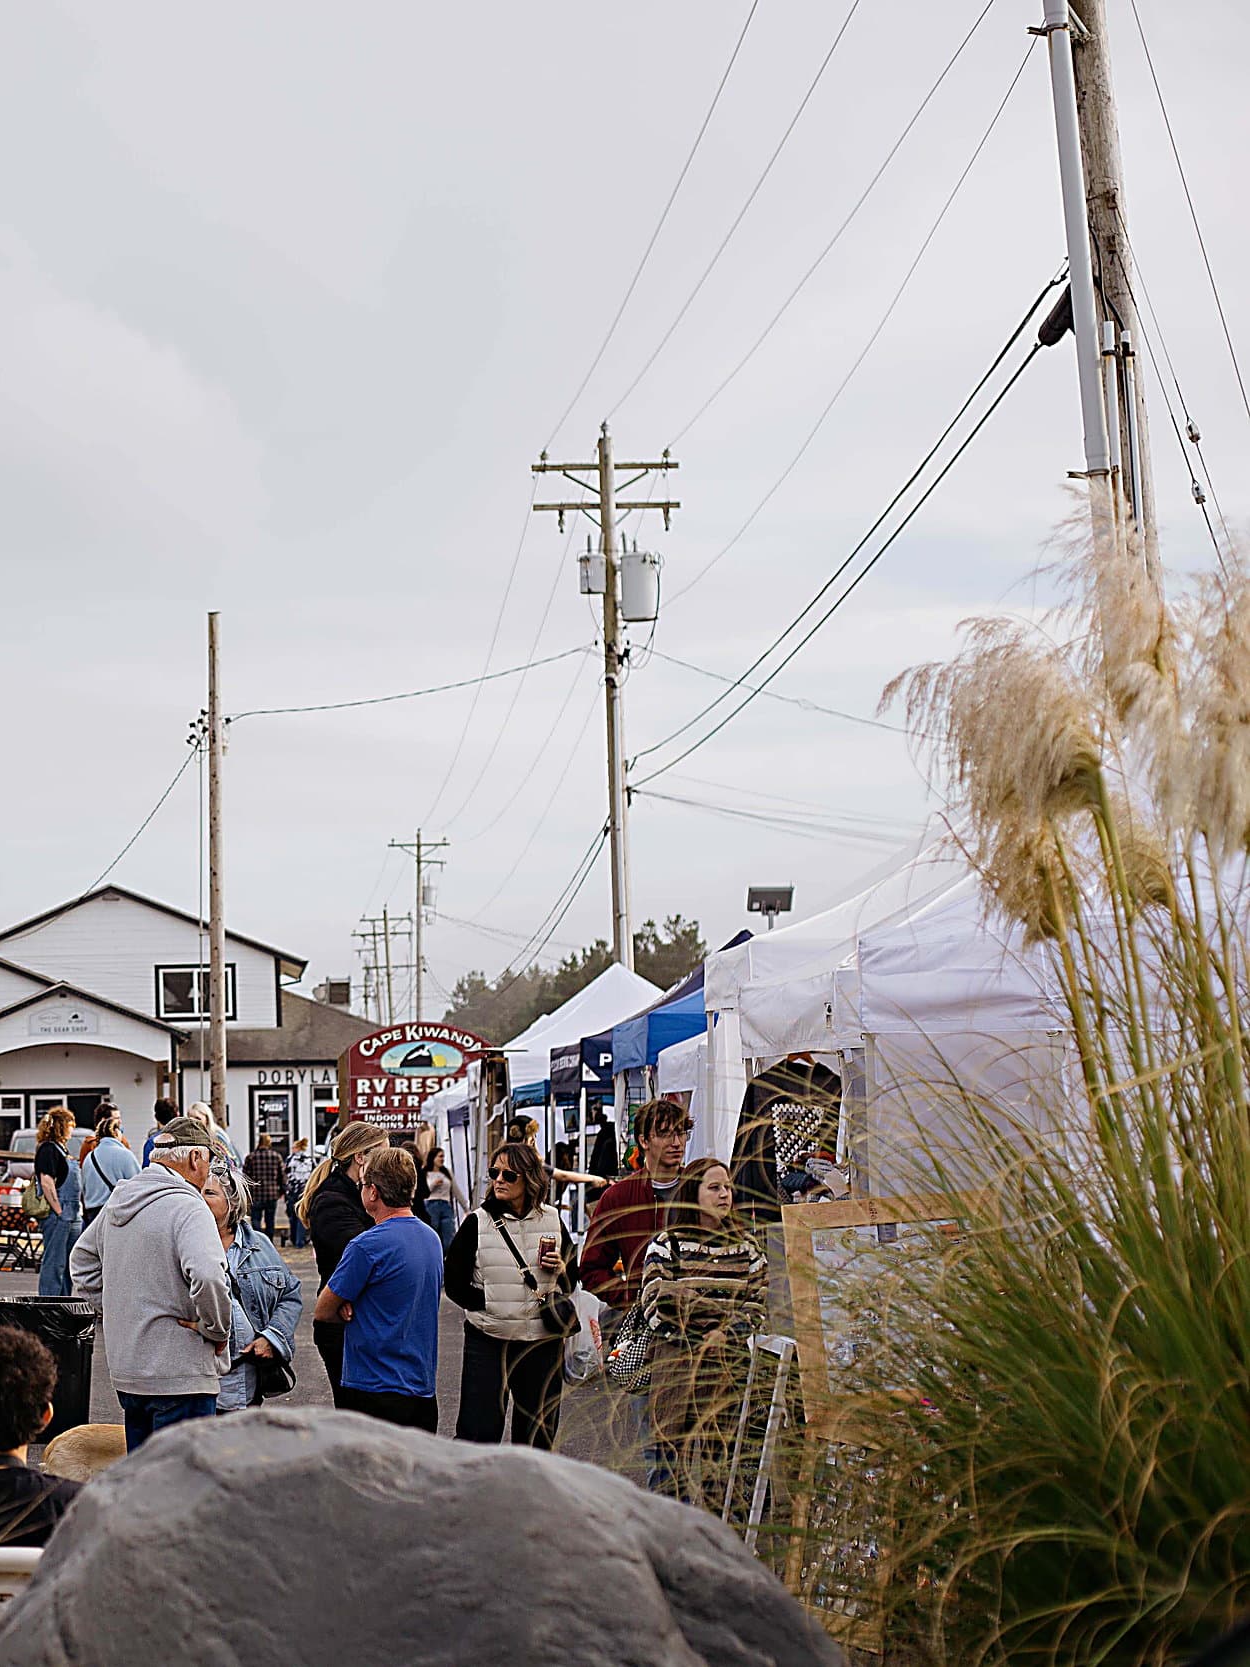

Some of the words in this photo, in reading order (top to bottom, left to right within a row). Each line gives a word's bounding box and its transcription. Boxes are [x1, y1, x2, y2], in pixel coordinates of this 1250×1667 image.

[359, 1029, 403, 1057] CAPE
[404, 1024, 483, 1050] KIWANDA
[357, 1078, 388, 1094] RV
[394, 1077, 464, 1094] RESO
[356, 1095, 420, 1108] ENTR
[365, 1113, 405, 1123] INDOOR
[370, 1121, 405, 1130] ABINS
